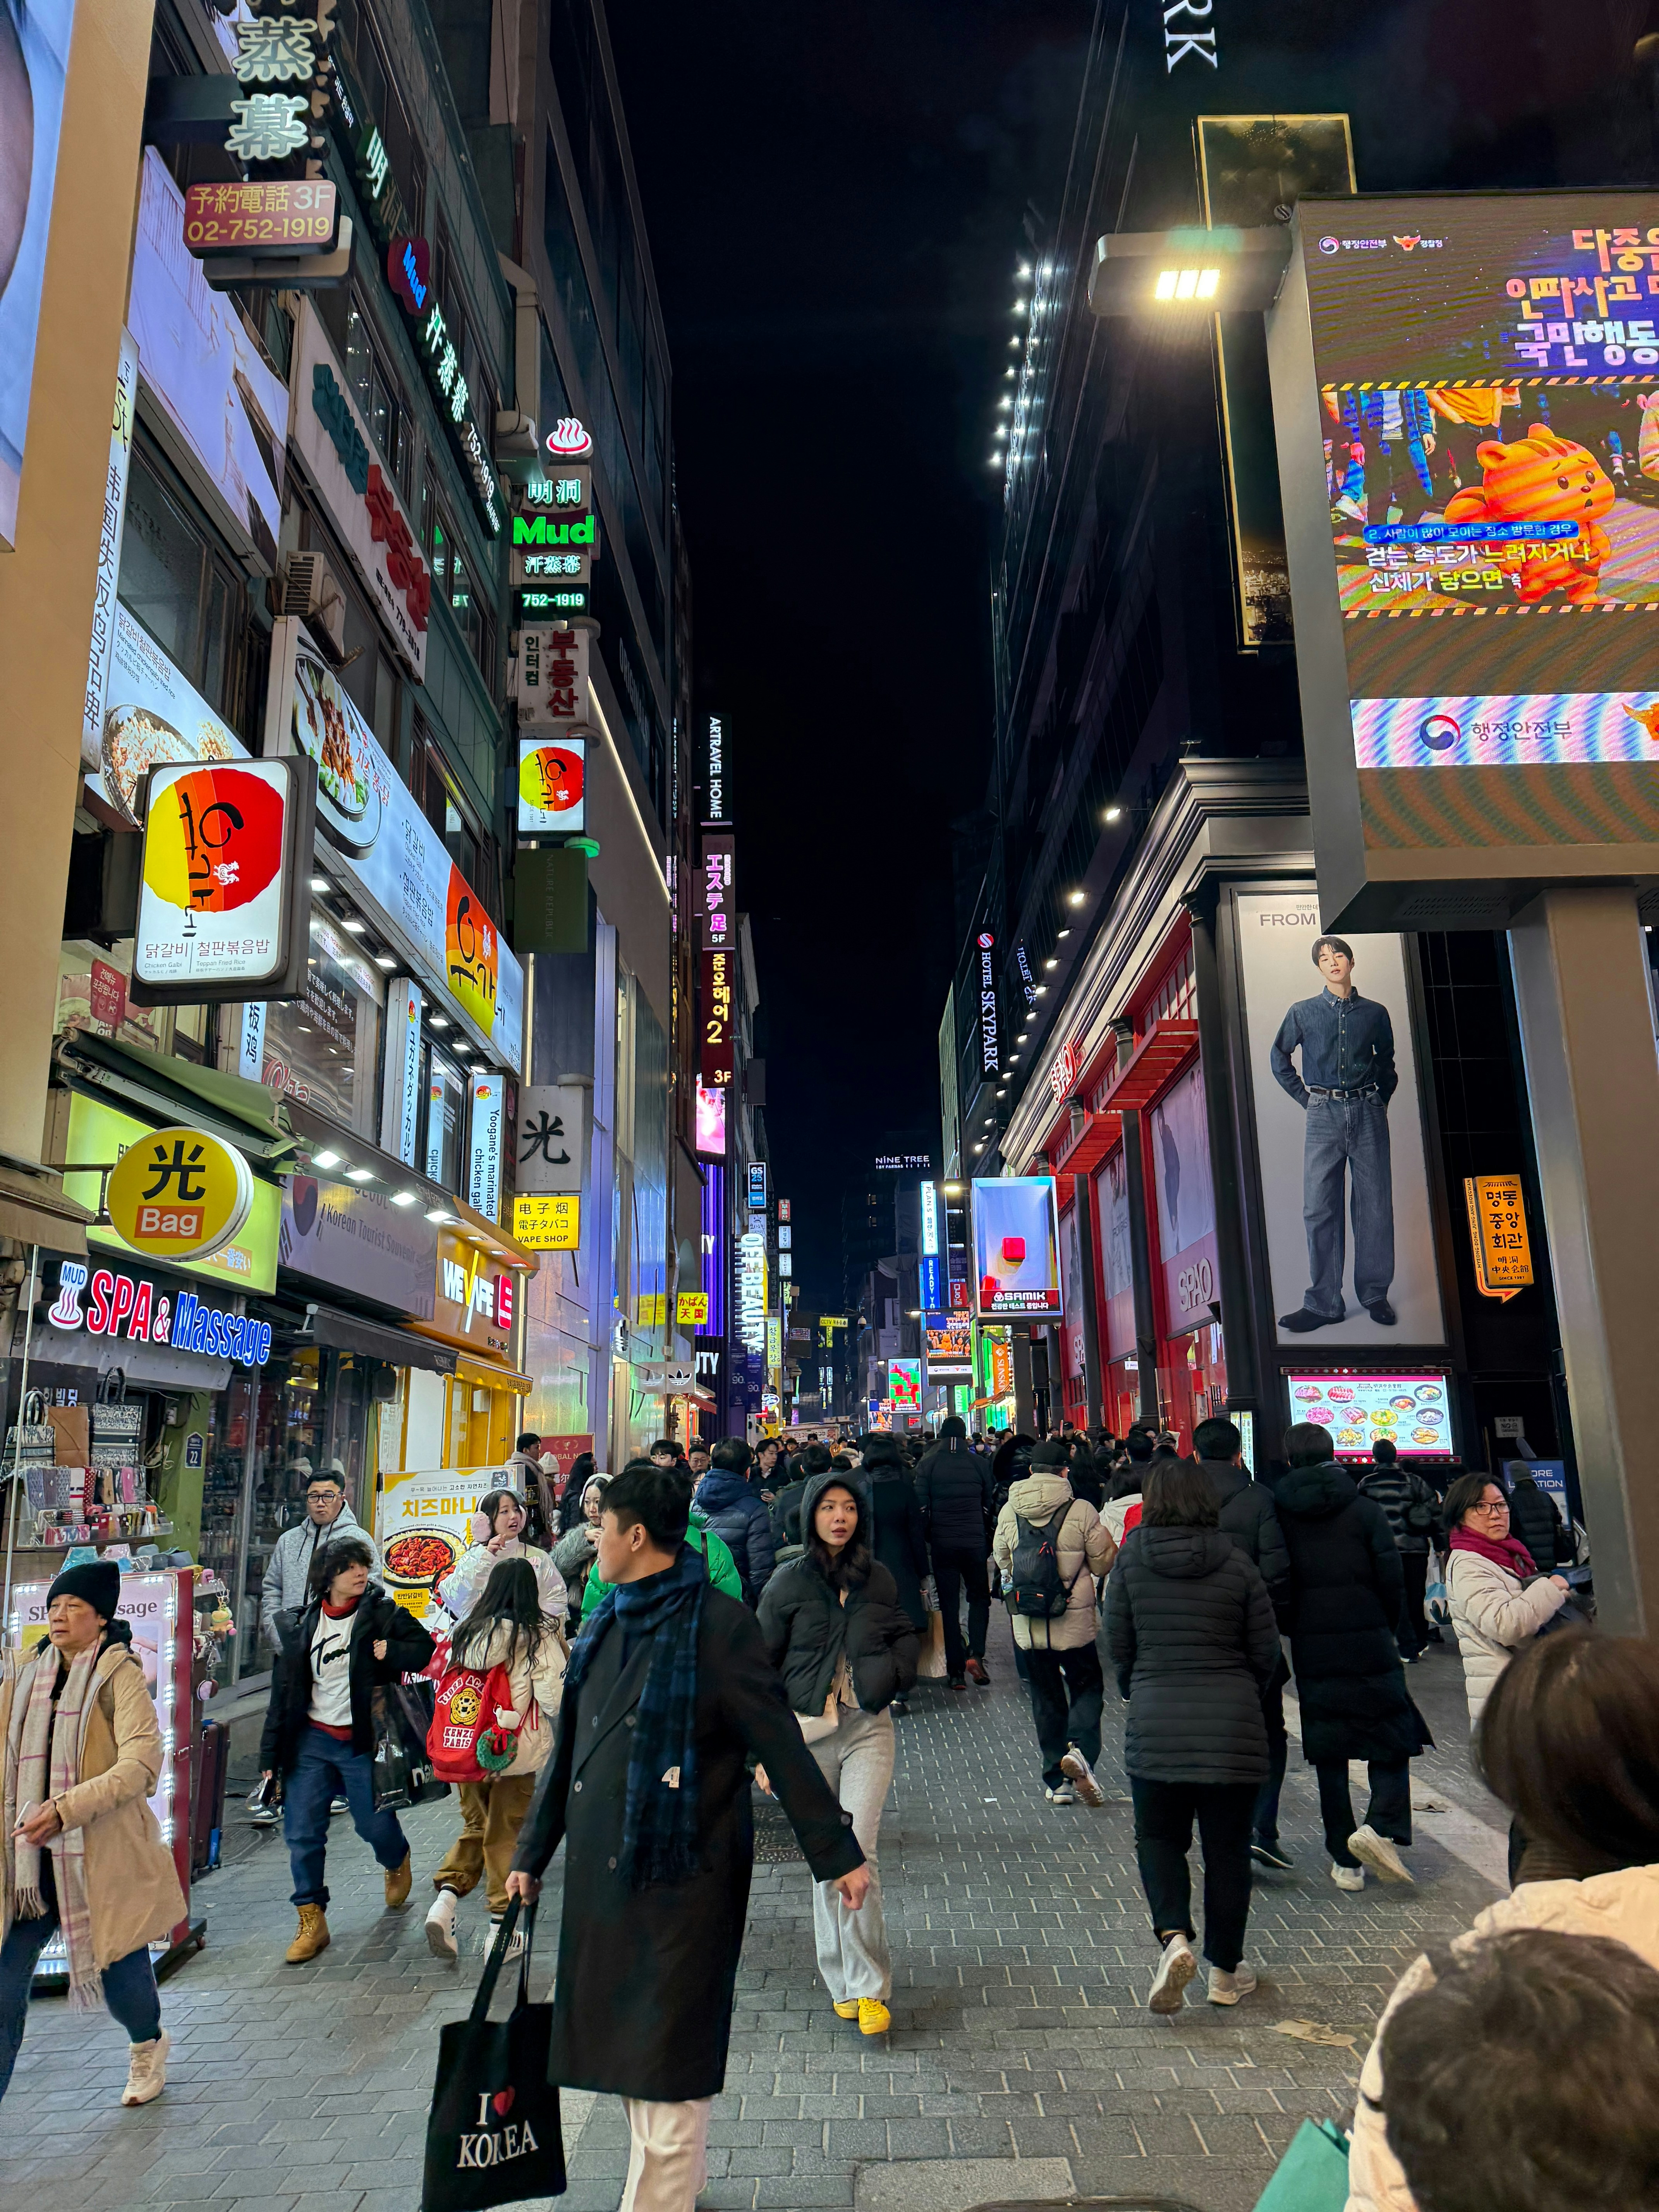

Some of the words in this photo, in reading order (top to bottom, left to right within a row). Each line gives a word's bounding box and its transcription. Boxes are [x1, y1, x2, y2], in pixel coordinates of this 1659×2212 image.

[191, 185, 291, 214] 予約電話
[293, 184, 331, 210] 3F
[187, 217, 330, 242] 02-752-1919
[1342, 239, 1387, 249] 행정안전부
[403, 242, 426, 309] Mud
[1506, 276, 1642, 320] 인파사고
[1515, 321, 1659, 368] 국민행동
[527, 479, 582, 504] 明洞
[513, 515, 595, 544] Mud
[1386, 529, 1419, 539] 사람이
[1422, 527, 1444, 538] 많이
[1448, 526, 1483, 538] 모이는
[1485, 526, 1508, 536] 장소
[1511, 525, 1546, 535] 방문한
[1549, 524, 1573, 534] 경우
[525, 555, 580, 575] 汗蒸幕
[1365, 546, 1409, 567] 걷는
[1413, 544, 1477, 565] 속도가
[1483, 542, 1590, 563] 느려지거나
[1369, 571, 1434, 592] 신체가
[522, 592, 585, 608] 752-1919
[525, 636, 539, 687] 인터컴
[548, 630, 579, 717] 부동산
[1471, 721, 1572, 742] 행정안전부
[709, 716, 721, 776] ARTRAVEL
[710, 779, 721, 818] HOME
[546, 854, 554, 891] NATURE
[544, 896, 554, 944] REPUBLIC
[1260, 913, 1316, 926] FROM
[145, 943, 188, 958] 닭갈비
[196, 939, 270, 957] 철판볶음밥
[711, 934, 726, 943] 5F
[982, 951, 994, 989] HOTEL
[93, 979, 120, 1002] 포장됩니다
[712, 953, 730, 1022] 준오헤어
[706, 1020, 723, 1044] 2
[981, 991, 998, 1072] SKYPARK
[714, 1070, 732, 1083] 3F
[488, 1109, 500, 1161] Yoogane's
[519, 1110, 571, 1164] 光
[141, 1140, 206, 1201] 光
[474, 1148, 483, 1188] chicken
[750, 1166, 763, 1175] GS
[486, 1164, 497, 1217] marinated
[1486, 1190, 1517, 1207] 명동
[519, 1202, 568, 1215] 电子烟
[1489, 1211, 1520, 1230] 중앙
[141, 1208, 199, 1236] Bag
[327, 1203, 356, 1235] Korean
[359, 1219, 385, 1249] Tourist
[519, 1219, 568, 1230] 電子タバコ
[1491, 1232, 1523, 1250] 회관
[62, 1265, 86, 1286] MUD
[1178, 1257, 1213, 1312] SPAO
[679, 1296, 707, 1307] かばん
[1004, 1292, 1046, 1300] SAMIK
[87, 1269, 153, 1343] SPA
[153, 1296, 169, 1343] &
[171, 1291, 271, 1367] Massage
[680, 1309, 704, 1319] 天国
[190, 1451, 198, 1464] 22
[443, 1736, 472, 1748] PARIS
[476, 2093, 492, 2126] I
[456, 2120, 539, 2168] KOREA
